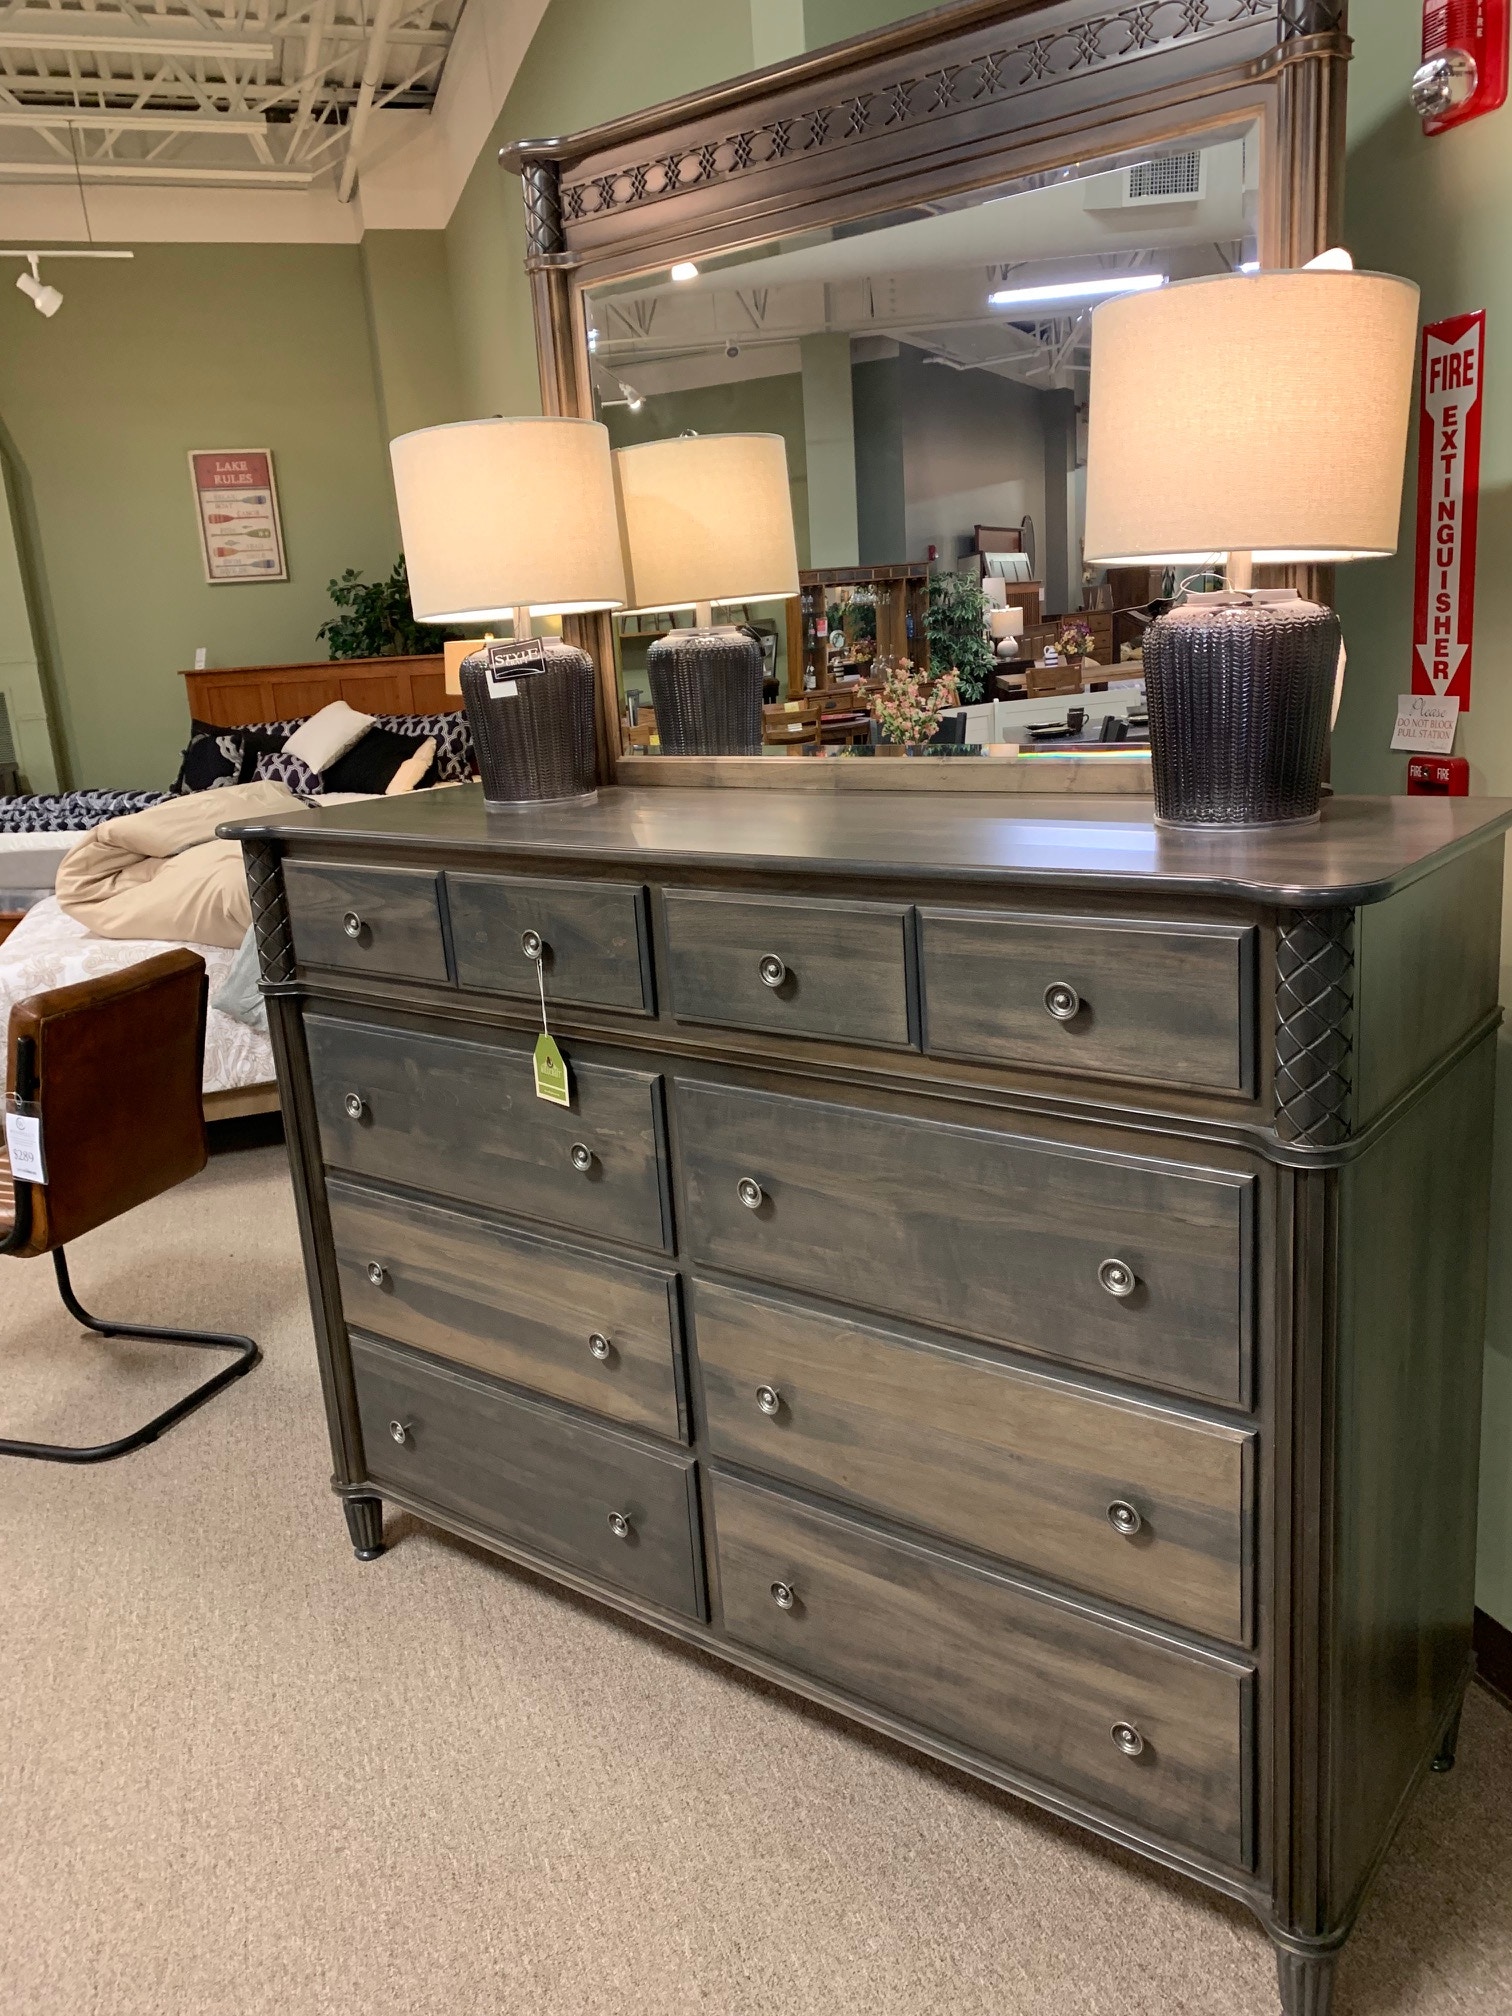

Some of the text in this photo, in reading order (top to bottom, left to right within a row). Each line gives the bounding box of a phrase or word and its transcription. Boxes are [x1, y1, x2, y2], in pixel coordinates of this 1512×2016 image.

[1430, 349, 1475, 394] FIRE
[215, 461, 248, 472] LAKE
[214, 474, 253, 484] RULES
[1433, 405, 1458, 680] EXTINGUISHER
[494, 648, 540, 666] STYLE
[1409, 697, 1447, 718] Please
[1397, 718, 1454, 729] DO NOT BLOCK
[1397, 728, 1451, 739] PULL STATION
[1410, 765, 1422, 778] FIRE
[1436, 767, 1450, 780] FIRE
[13, 1148, 35, 1163] $289
